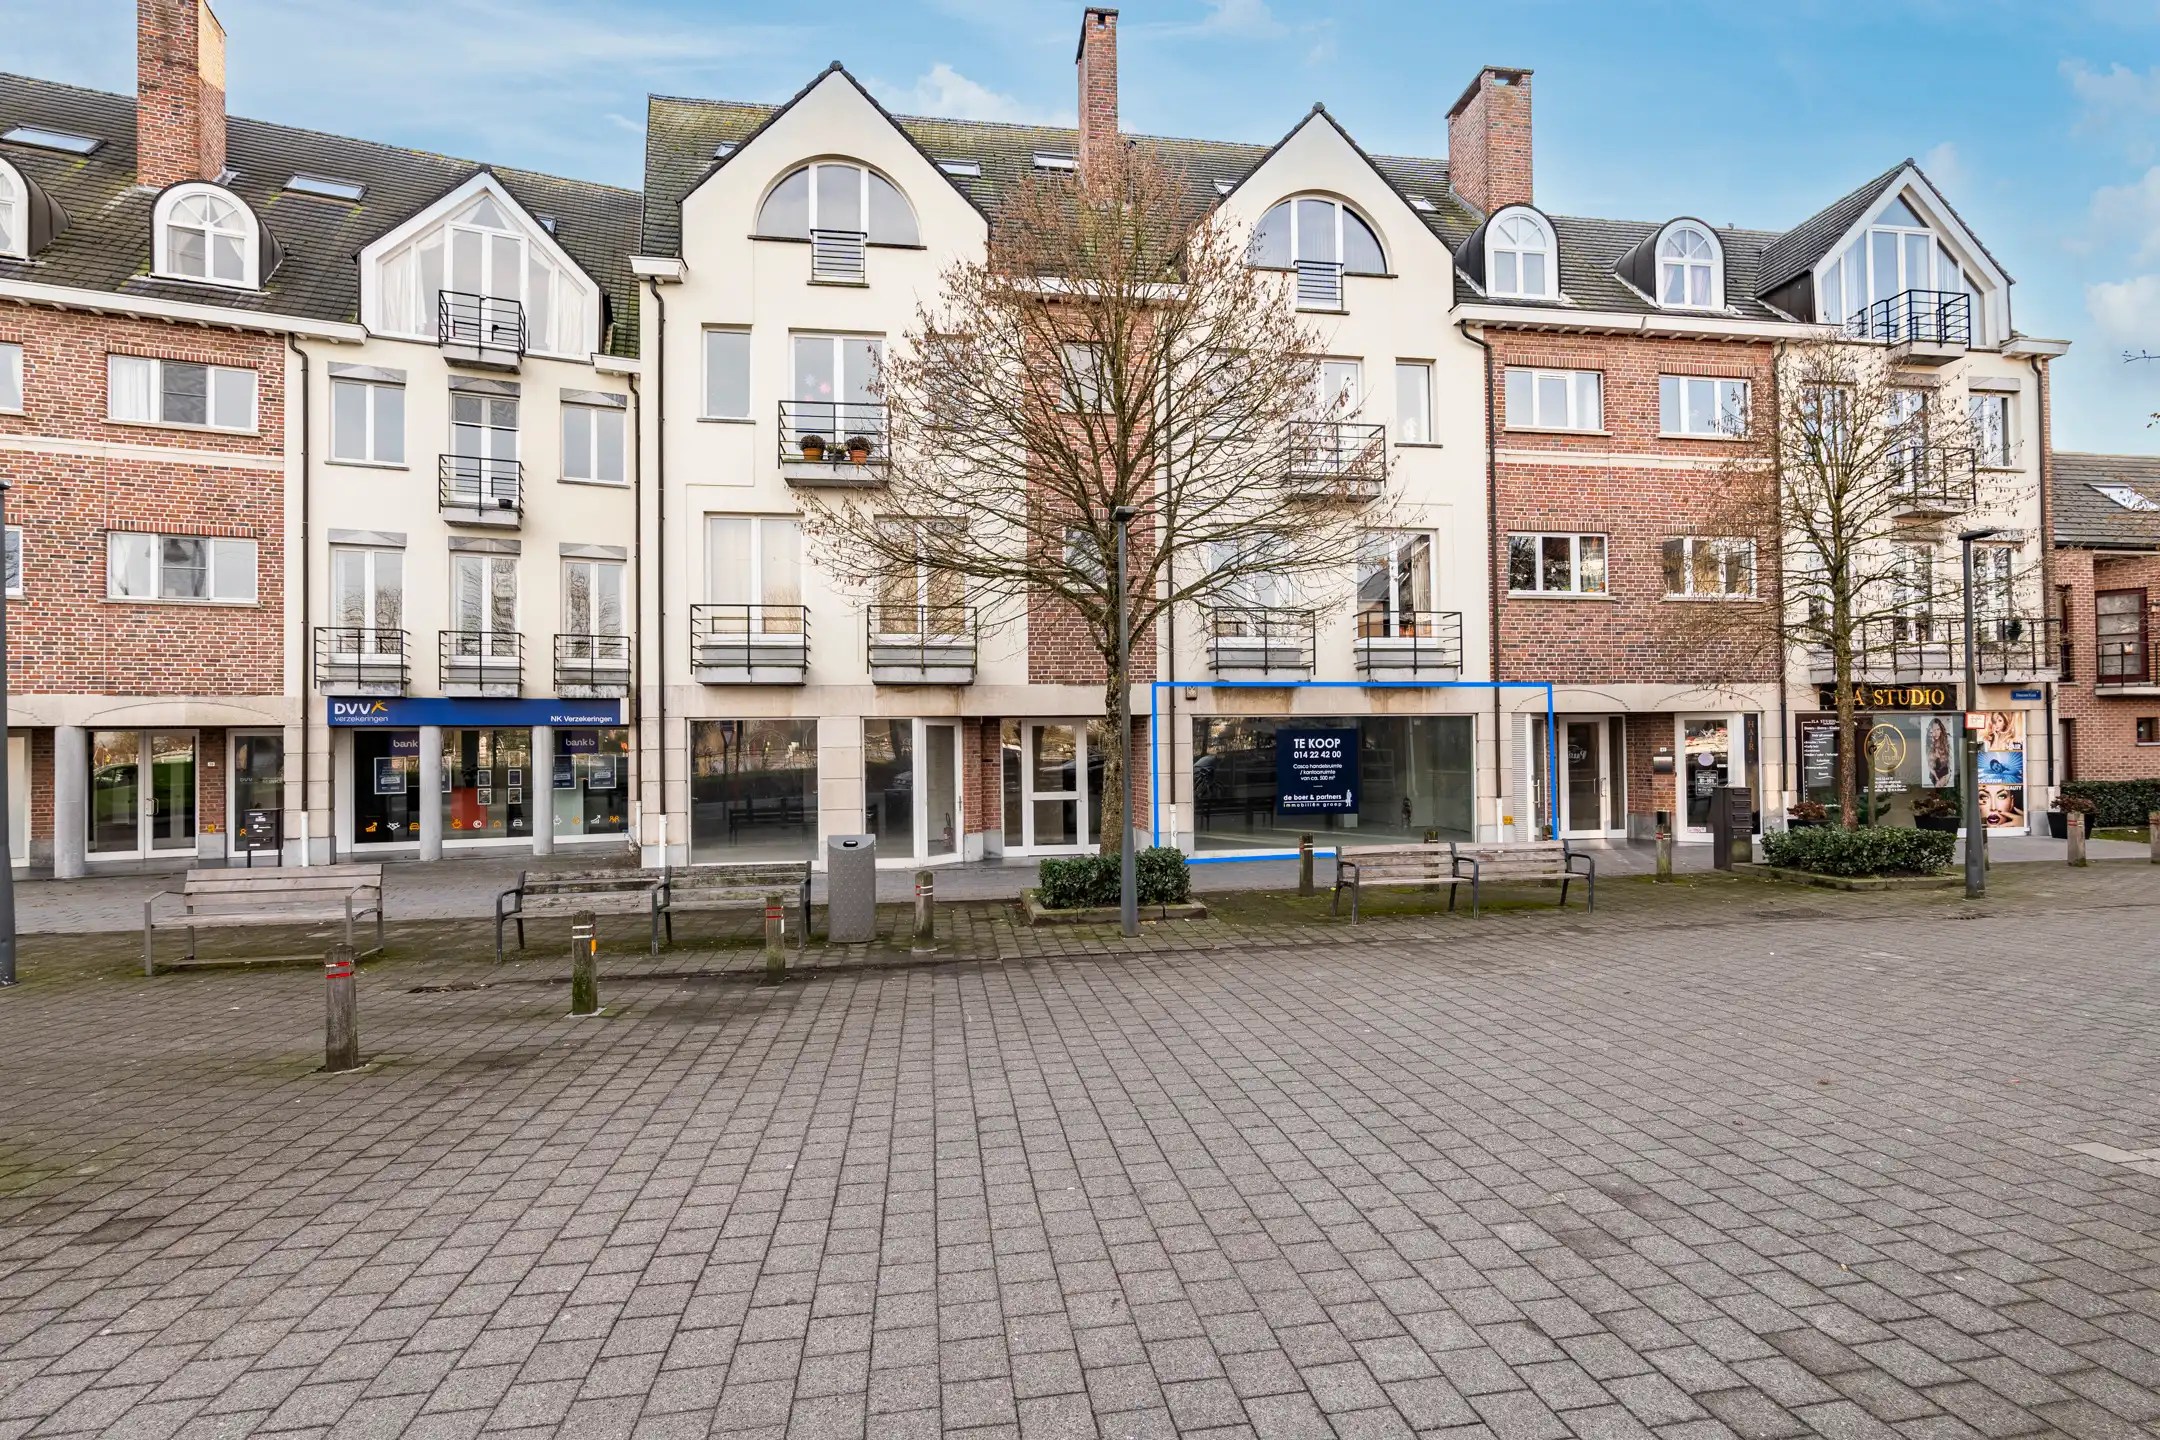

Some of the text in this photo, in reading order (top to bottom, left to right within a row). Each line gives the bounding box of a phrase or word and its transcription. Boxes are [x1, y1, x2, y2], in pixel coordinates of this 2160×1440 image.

[1873, 689, 1945, 705] STUDIO
[334, 703, 371, 715] DVV
[334, 715, 389, 723] verzekeringen
[563, 715, 613, 723] Verzekeringen
[1747, 720, 1755, 751] HAIR
[393, 739, 419, 748] bank
[565, 738, 588, 747] bank
[1294, 738, 1341, 748] TE KOOP
